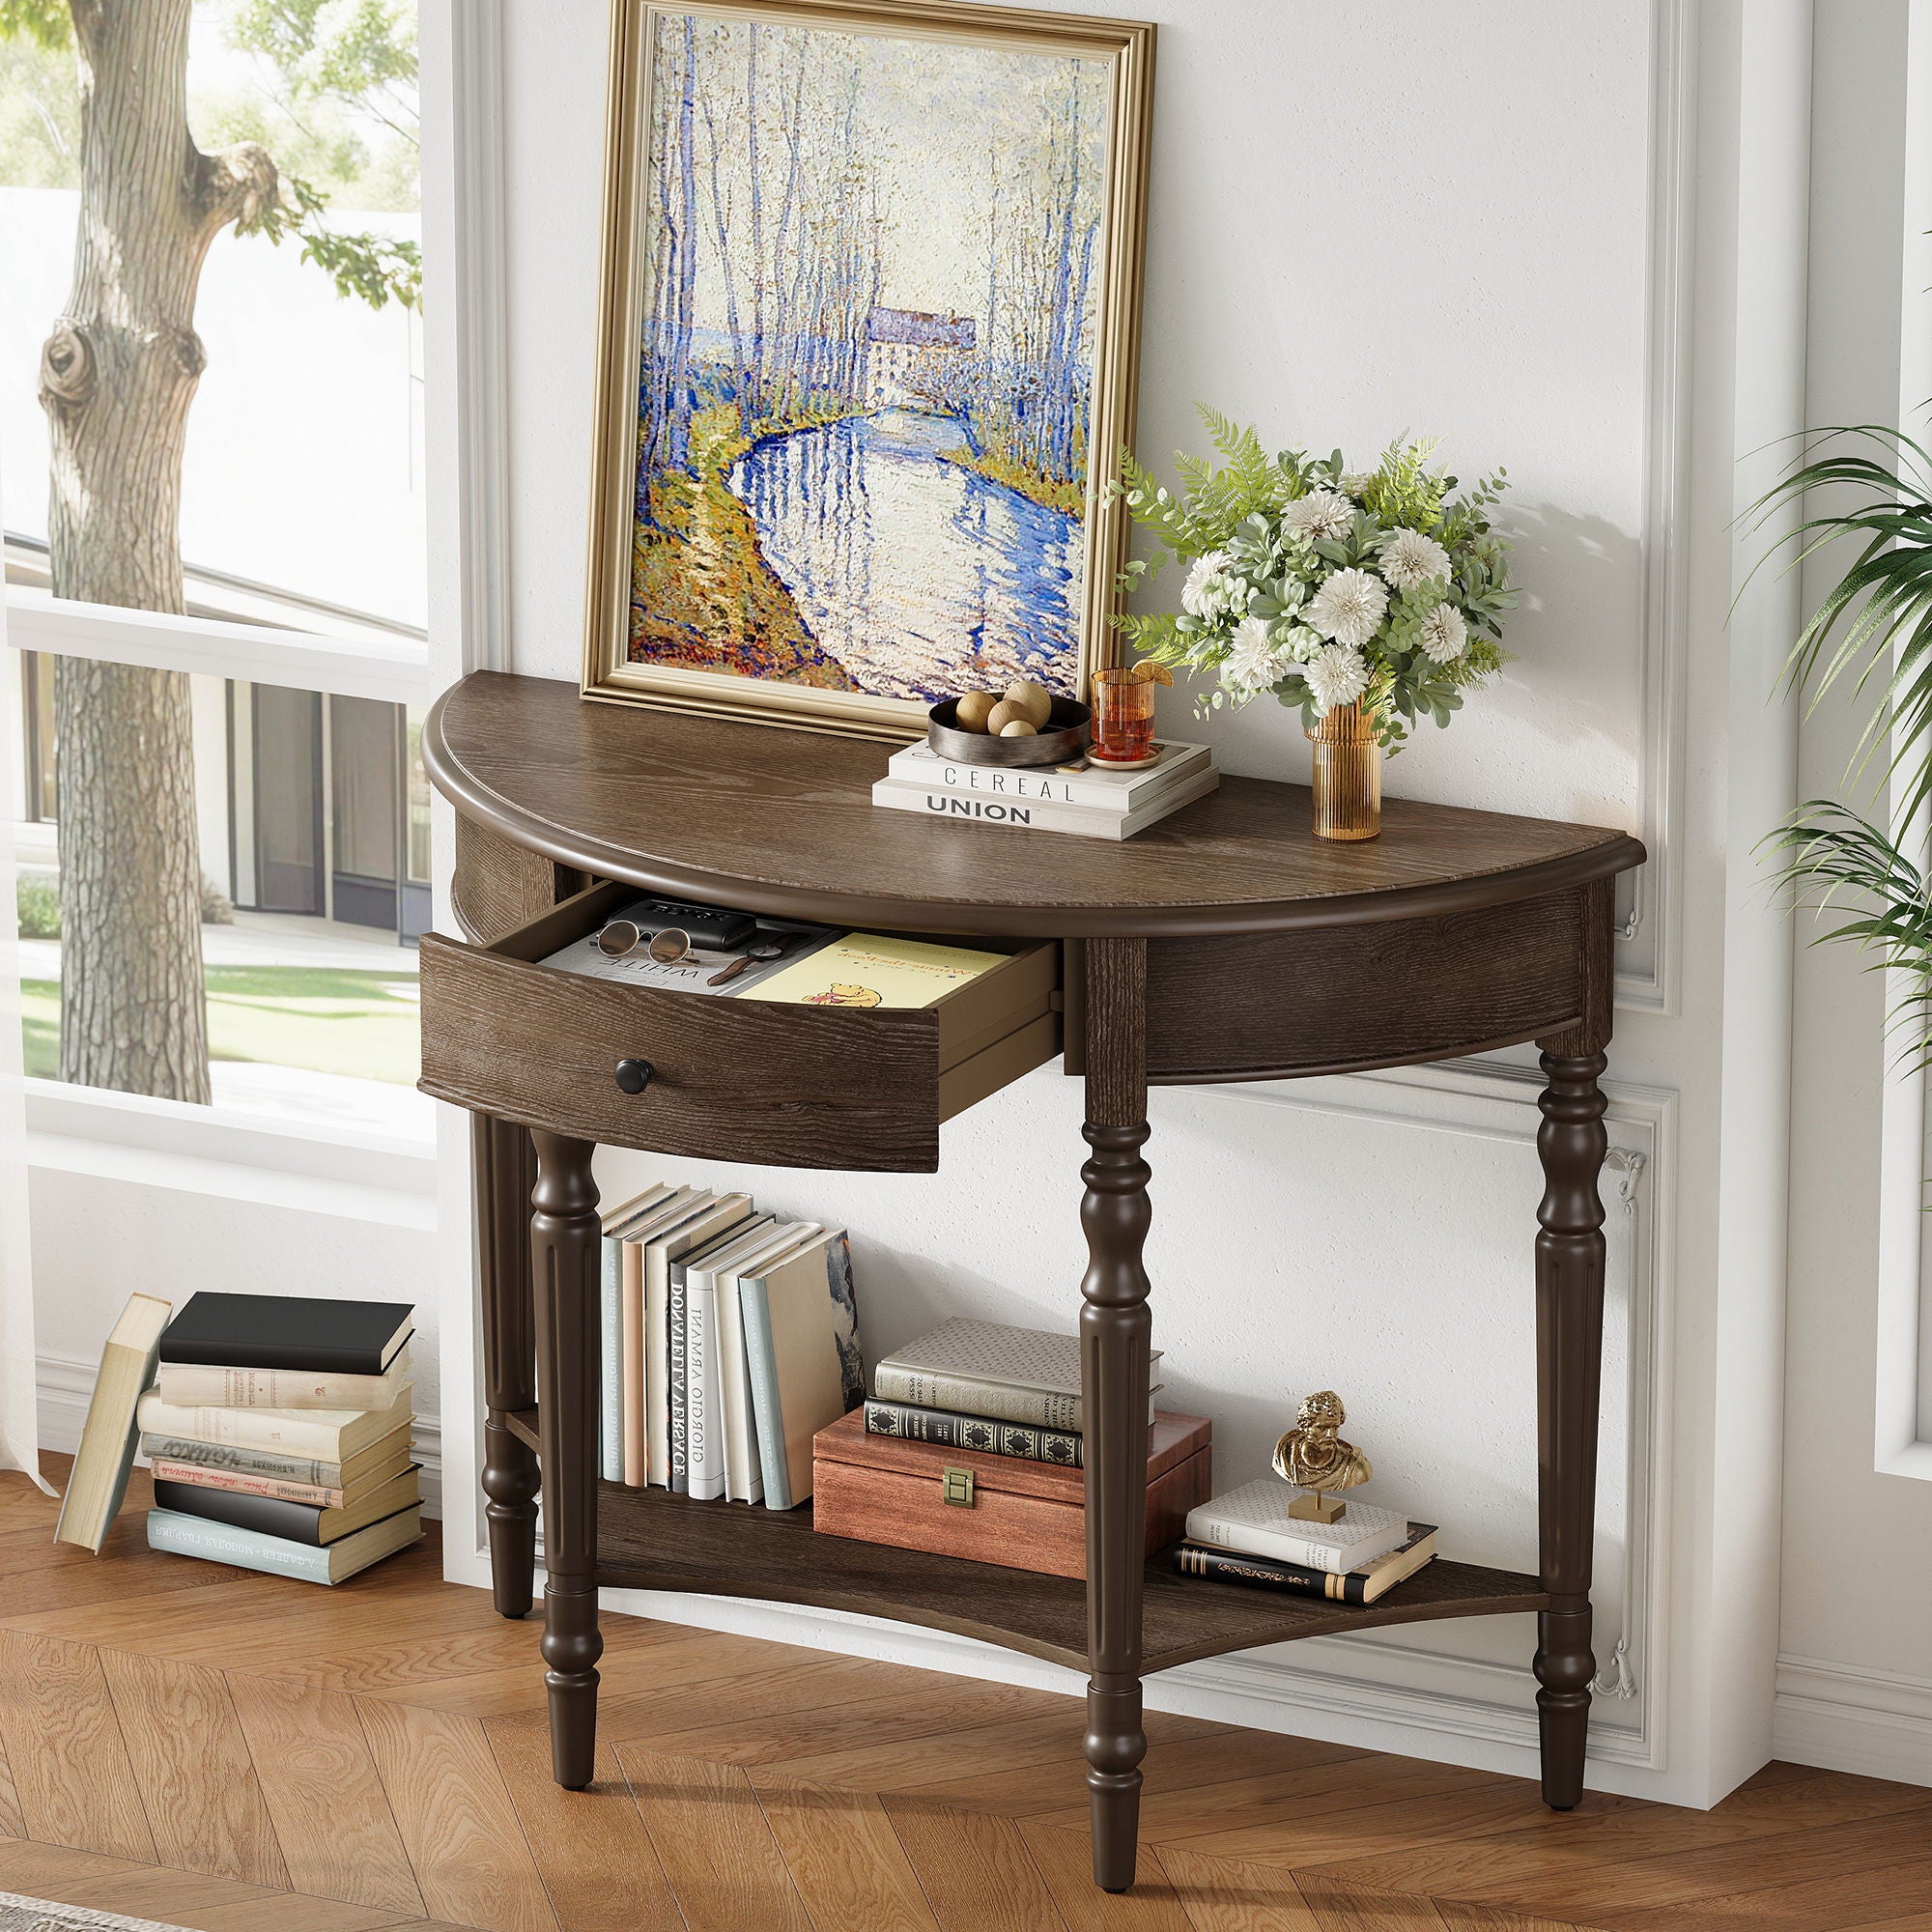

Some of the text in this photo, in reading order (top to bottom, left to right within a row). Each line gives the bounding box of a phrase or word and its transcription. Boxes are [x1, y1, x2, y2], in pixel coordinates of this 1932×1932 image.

[945, 767, 1074, 803] CEREAL
[927, 795, 1031, 824] UNION
[599, 958, 699, 979] WHITE
[155, 1524, 202, 1545] ГВАРДИЯ
[204, 1536, 255, 1555] МОЛОДАЯ
